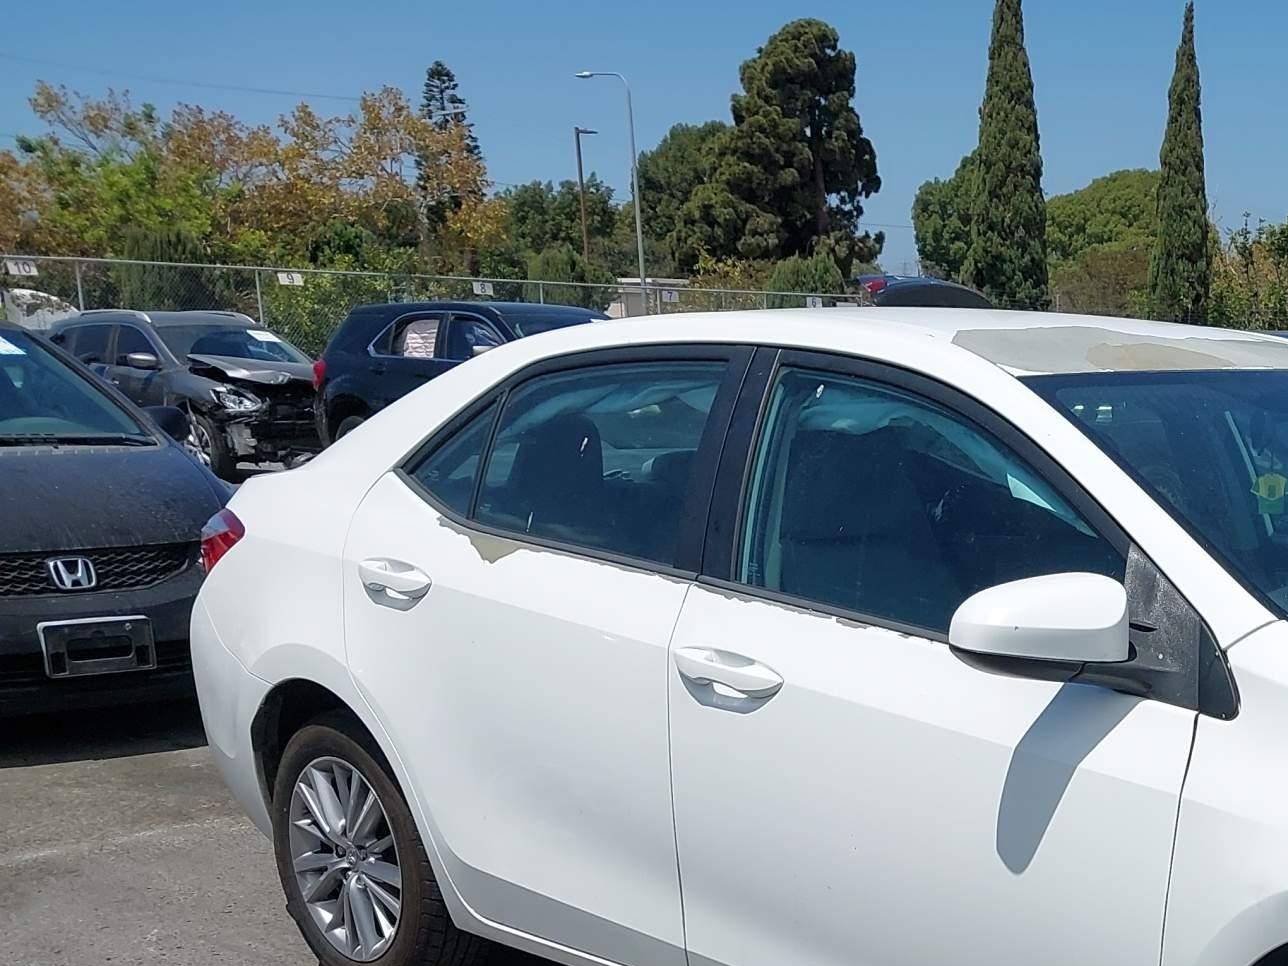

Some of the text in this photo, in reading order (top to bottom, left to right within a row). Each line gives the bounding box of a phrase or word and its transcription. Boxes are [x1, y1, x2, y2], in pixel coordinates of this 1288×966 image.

[14, 261, 31, 274] 10
[286, 272, 295, 284] 9
[480, 283, 487, 294] 8
[667, 291, 673, 301] 7
